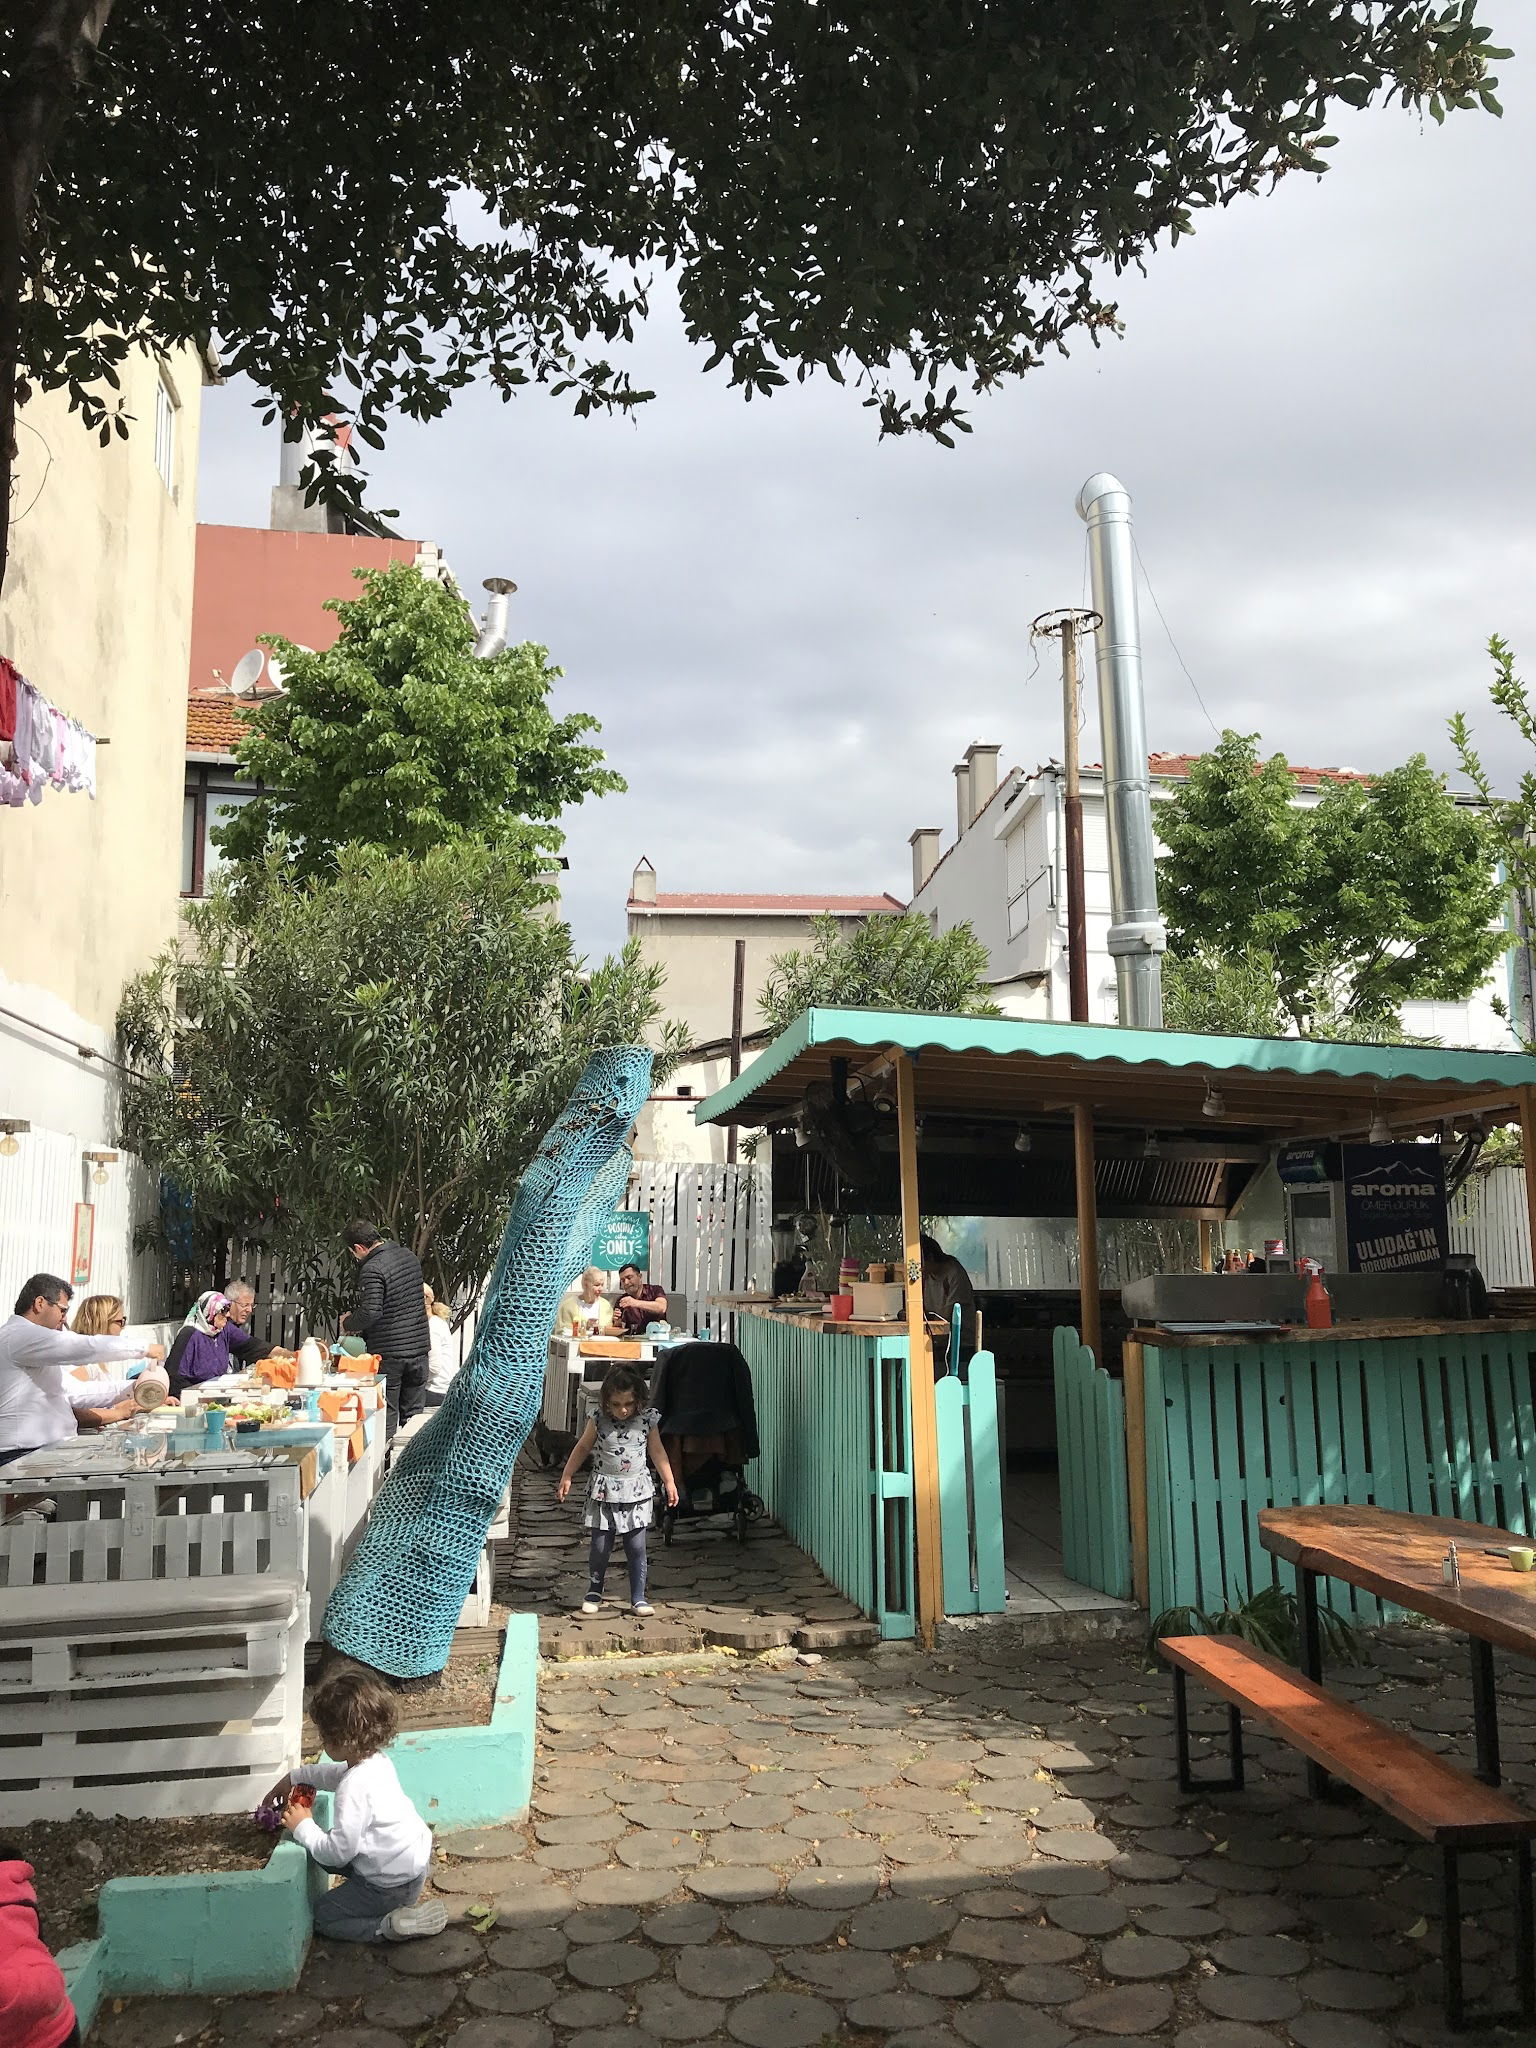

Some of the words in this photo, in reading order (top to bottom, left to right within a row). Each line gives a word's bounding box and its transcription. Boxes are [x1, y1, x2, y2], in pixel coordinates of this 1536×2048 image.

[1286, 1150, 1315, 1160] aroma
[1350, 1184, 1436, 1196] aroma
[606, 1240, 635, 1255] ONLY
[1356, 1226, 1438, 1260] ULUDAĞ'IN
[1359, 1247, 1441, 1273] DORUKLARINDAN
